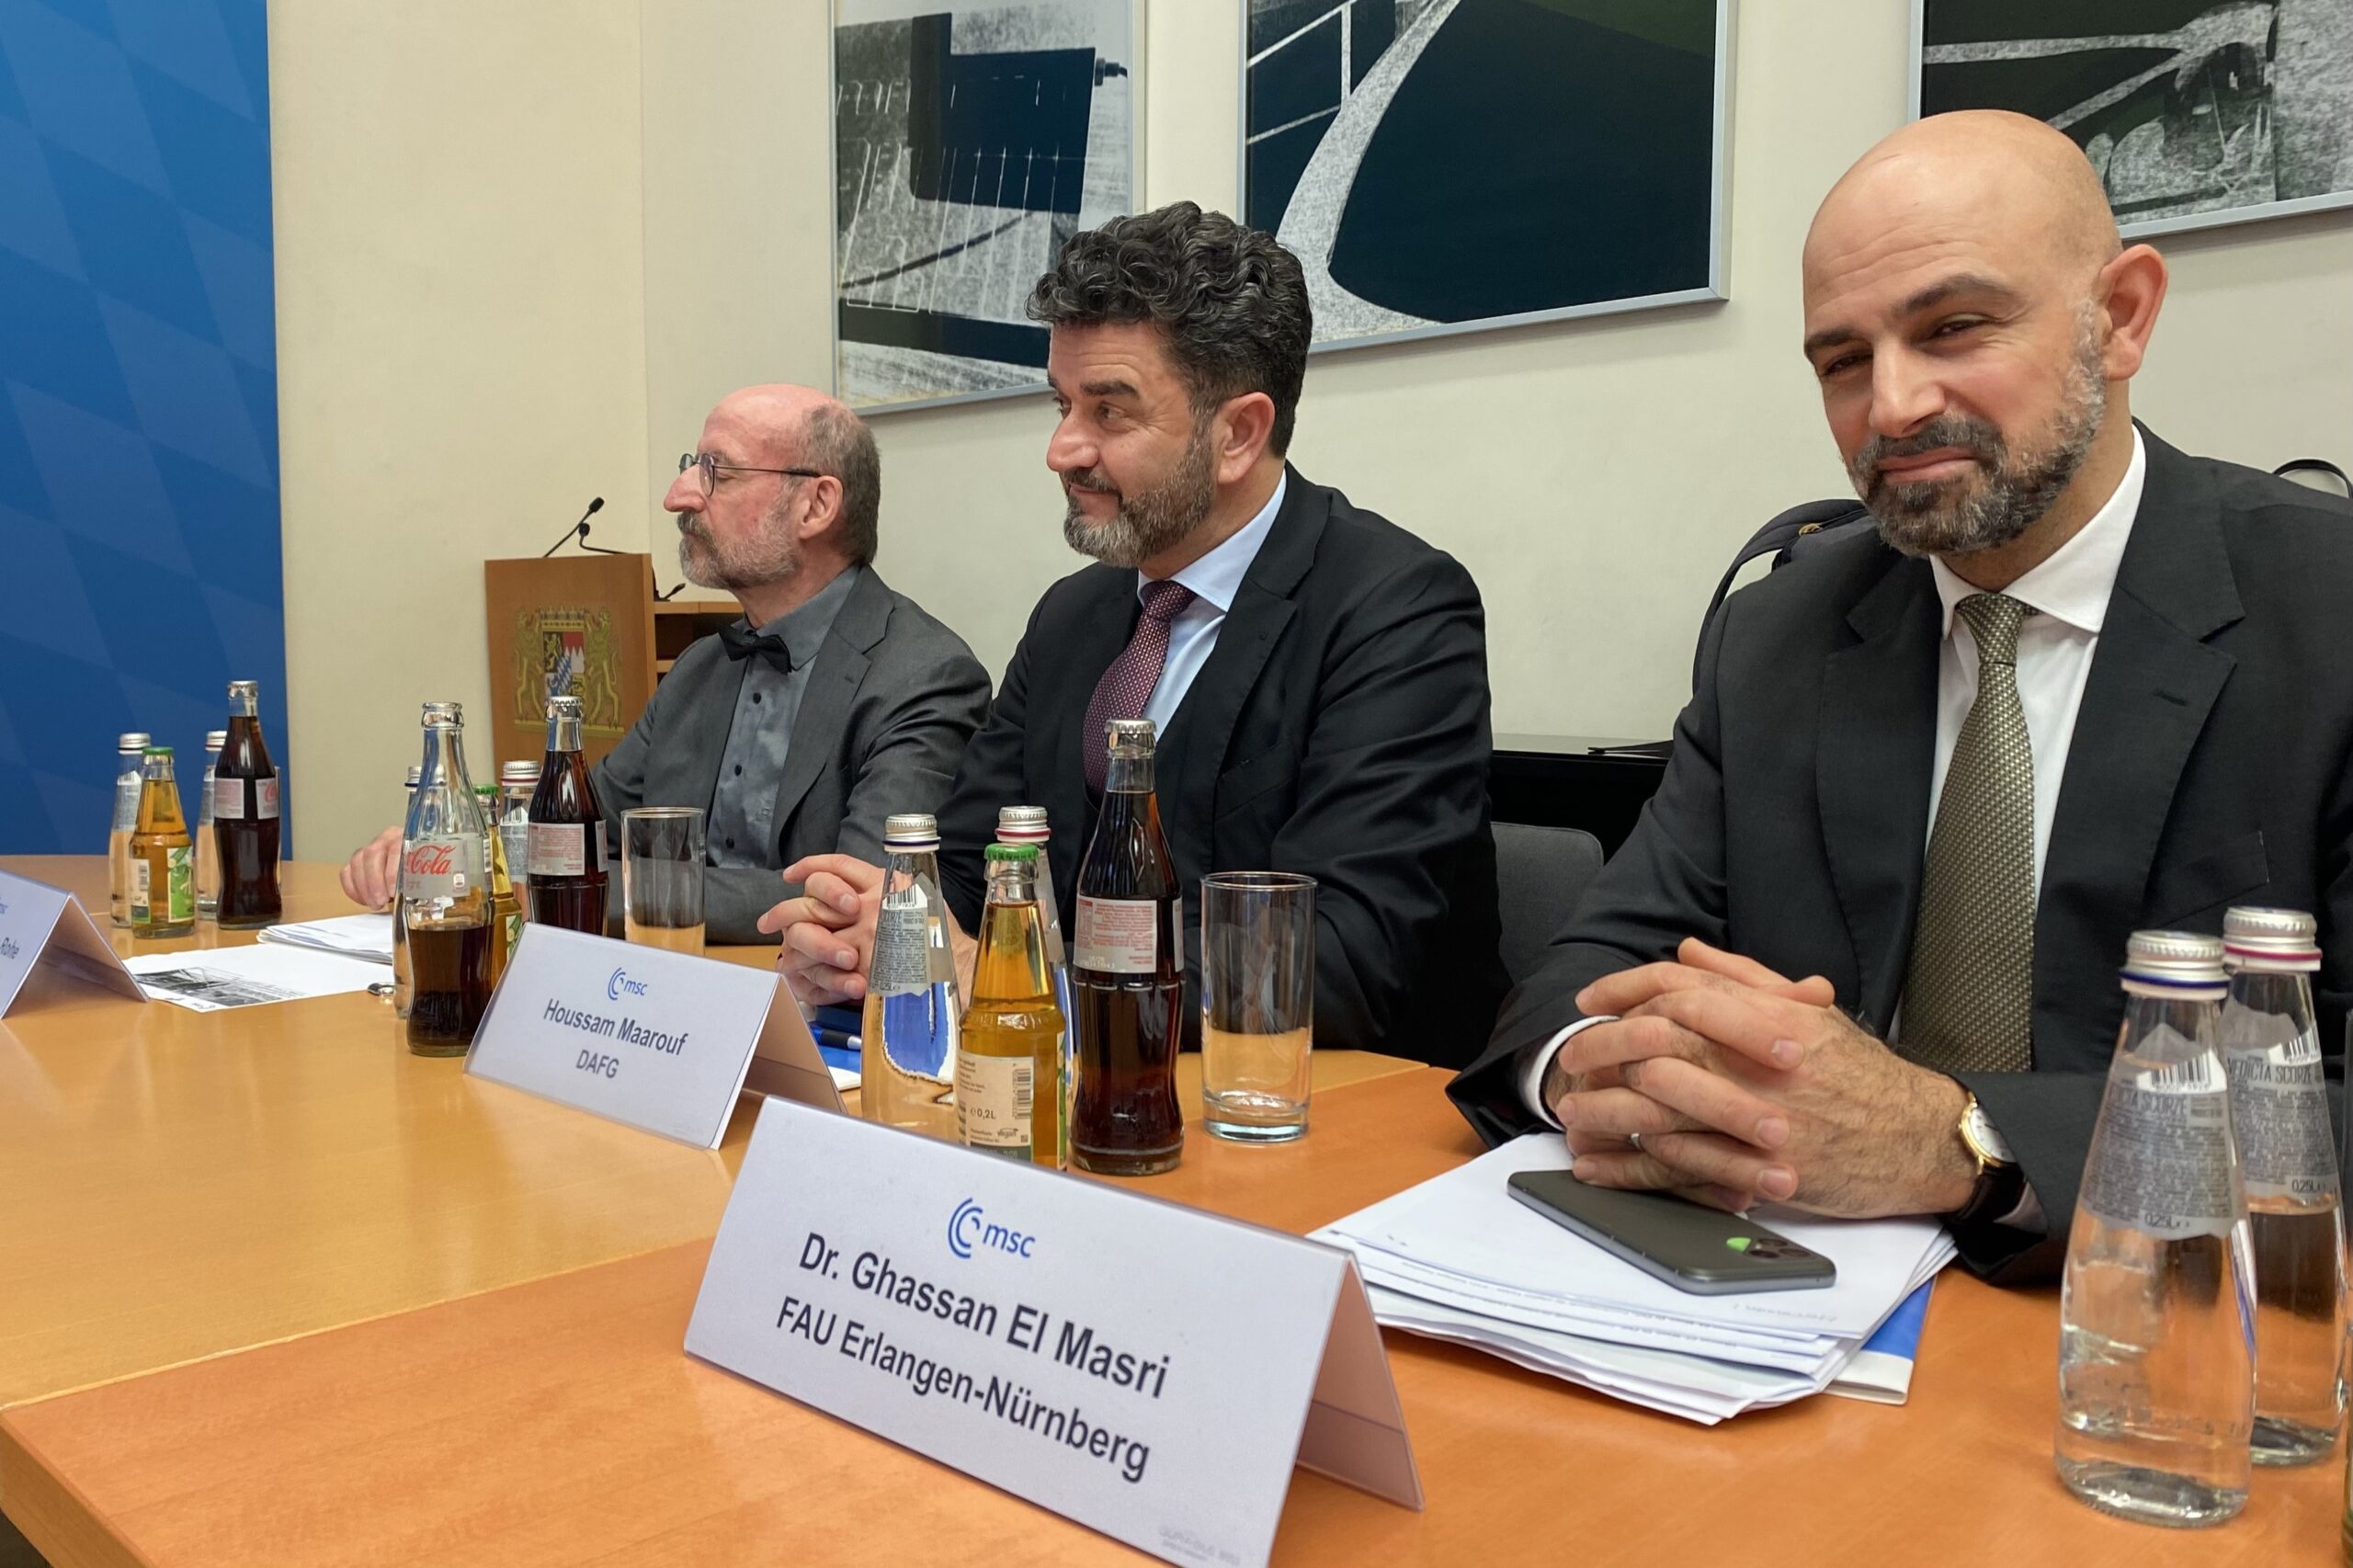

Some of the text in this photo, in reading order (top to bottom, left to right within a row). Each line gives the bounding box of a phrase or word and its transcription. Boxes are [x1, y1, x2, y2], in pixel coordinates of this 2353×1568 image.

[623, 979, 648, 996] msc
[543, 998, 688, 1056] Houssam Maarouf
[575, 1049, 620, 1078] DAFG
[976, 1108, 997, 1120] 0,2L
[982, 1223, 1036, 1258] msc
[799, 1232, 1170, 1399] Dr. Ghassan El Masri
[777, 1296, 1150, 1483] FAU Erlangen-Nürnberg
